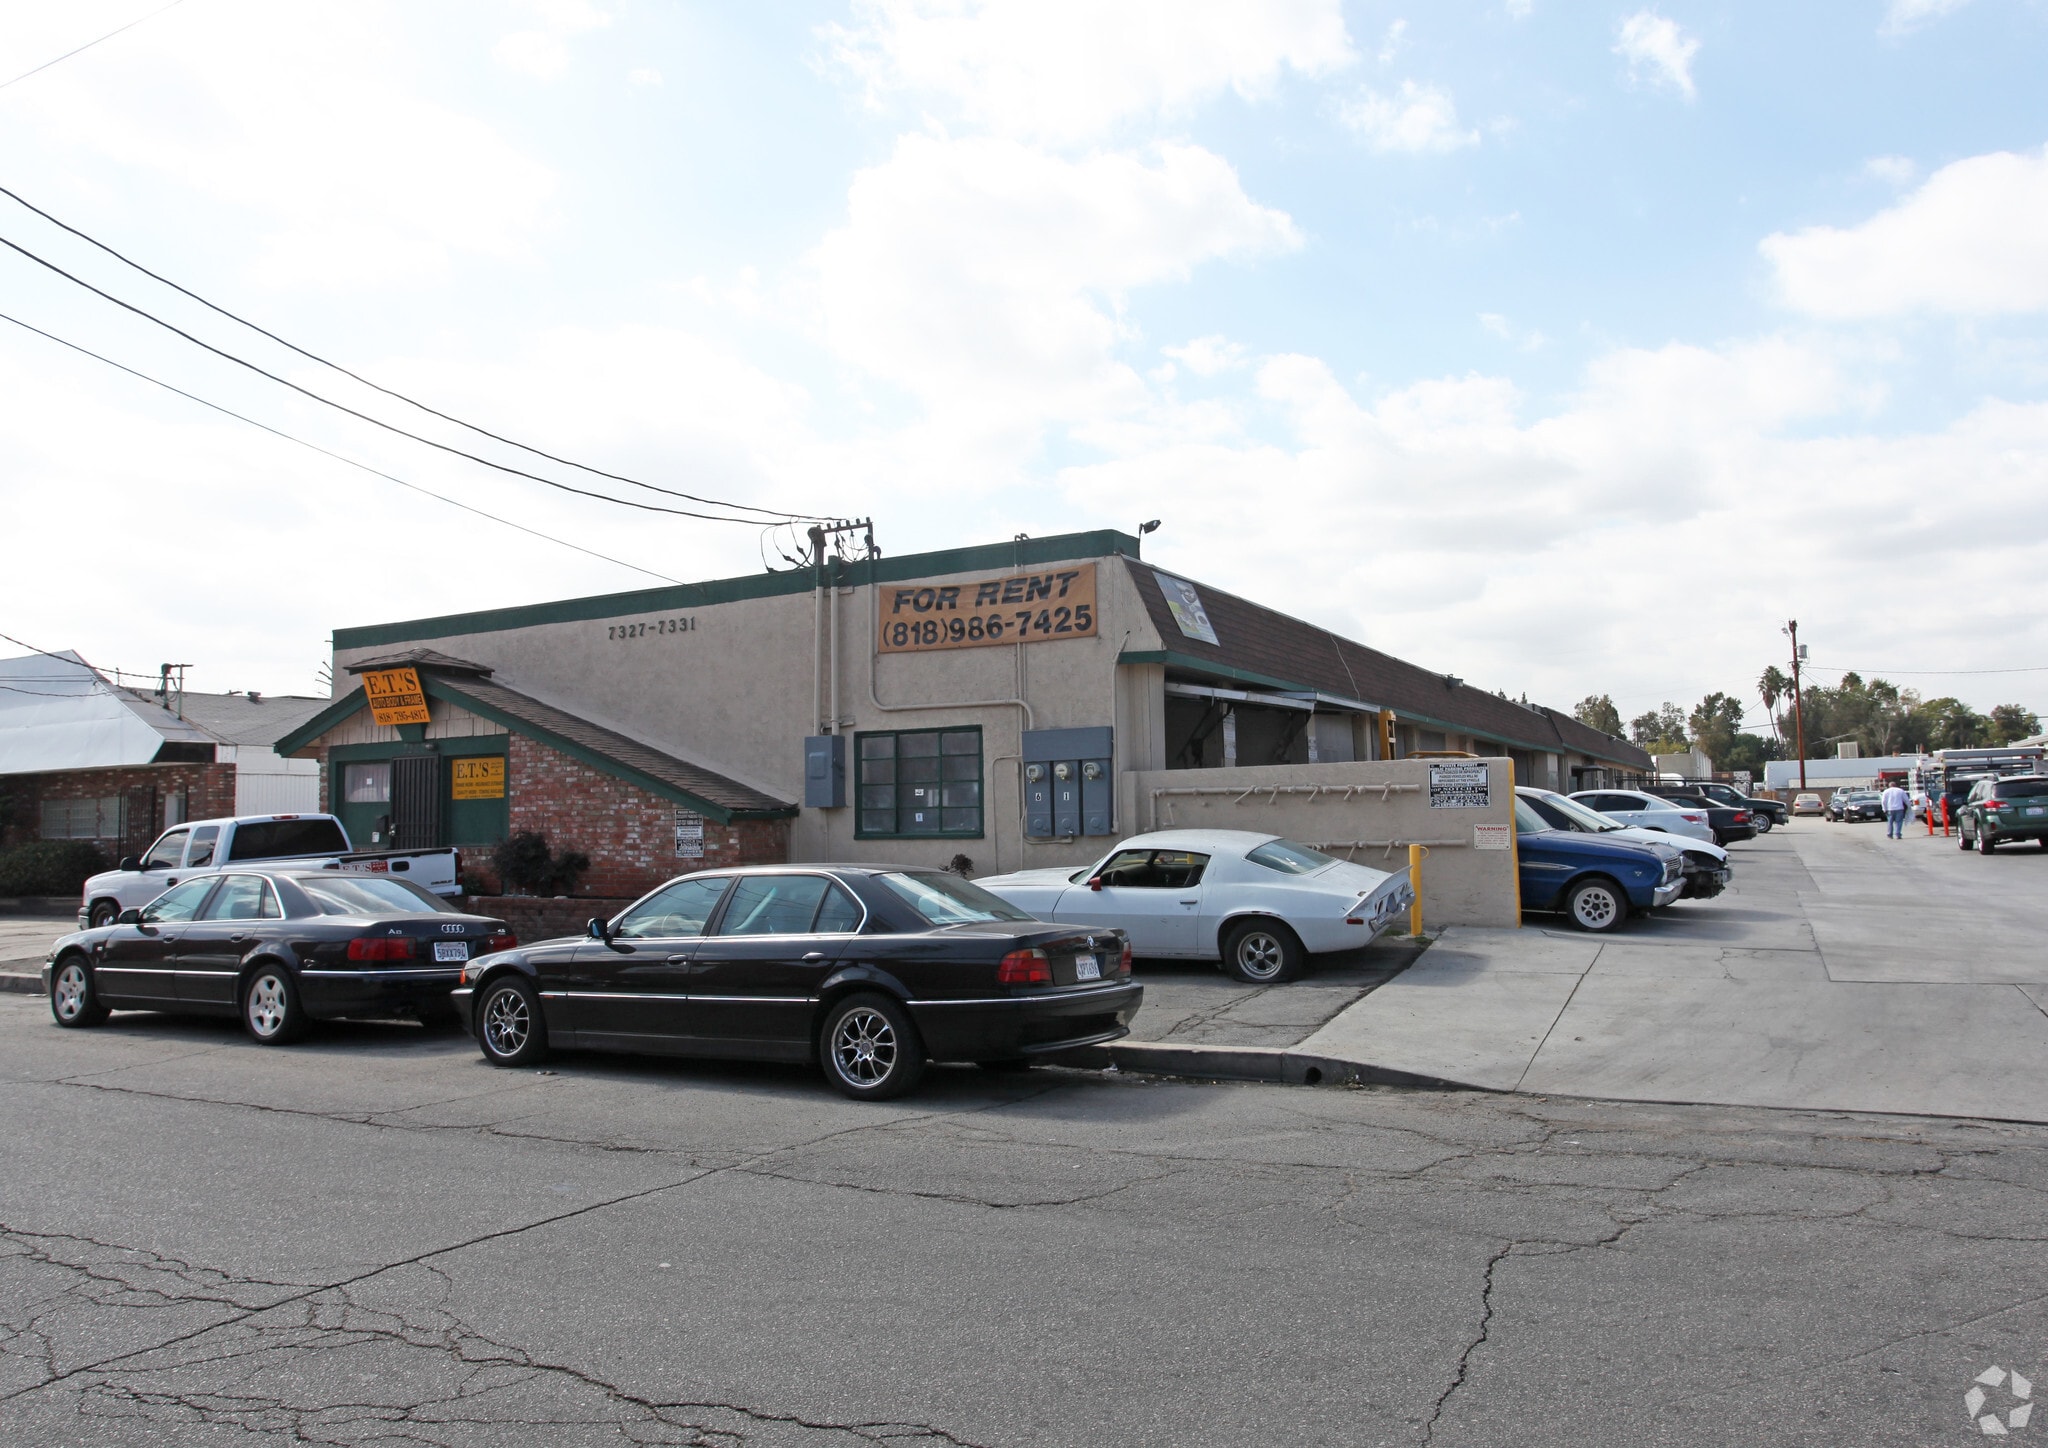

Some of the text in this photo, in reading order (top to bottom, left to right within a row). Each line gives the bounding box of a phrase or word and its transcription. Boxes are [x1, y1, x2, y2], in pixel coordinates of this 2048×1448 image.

[892, 571, 1079, 614] FOR RENT
[608, 616, 696, 640] 7327-7331
[883, 604, 1093, 647] (818)986-7425
[366, 671, 417, 695] E.T.'S
[372, 698, 386, 709] AUTO
[386, 696, 400, 707] BODY
[404, 694, 422, 706] FRAME
[377, 712, 393, 723] (818)
[456, 762, 489, 779] E.T.'S
